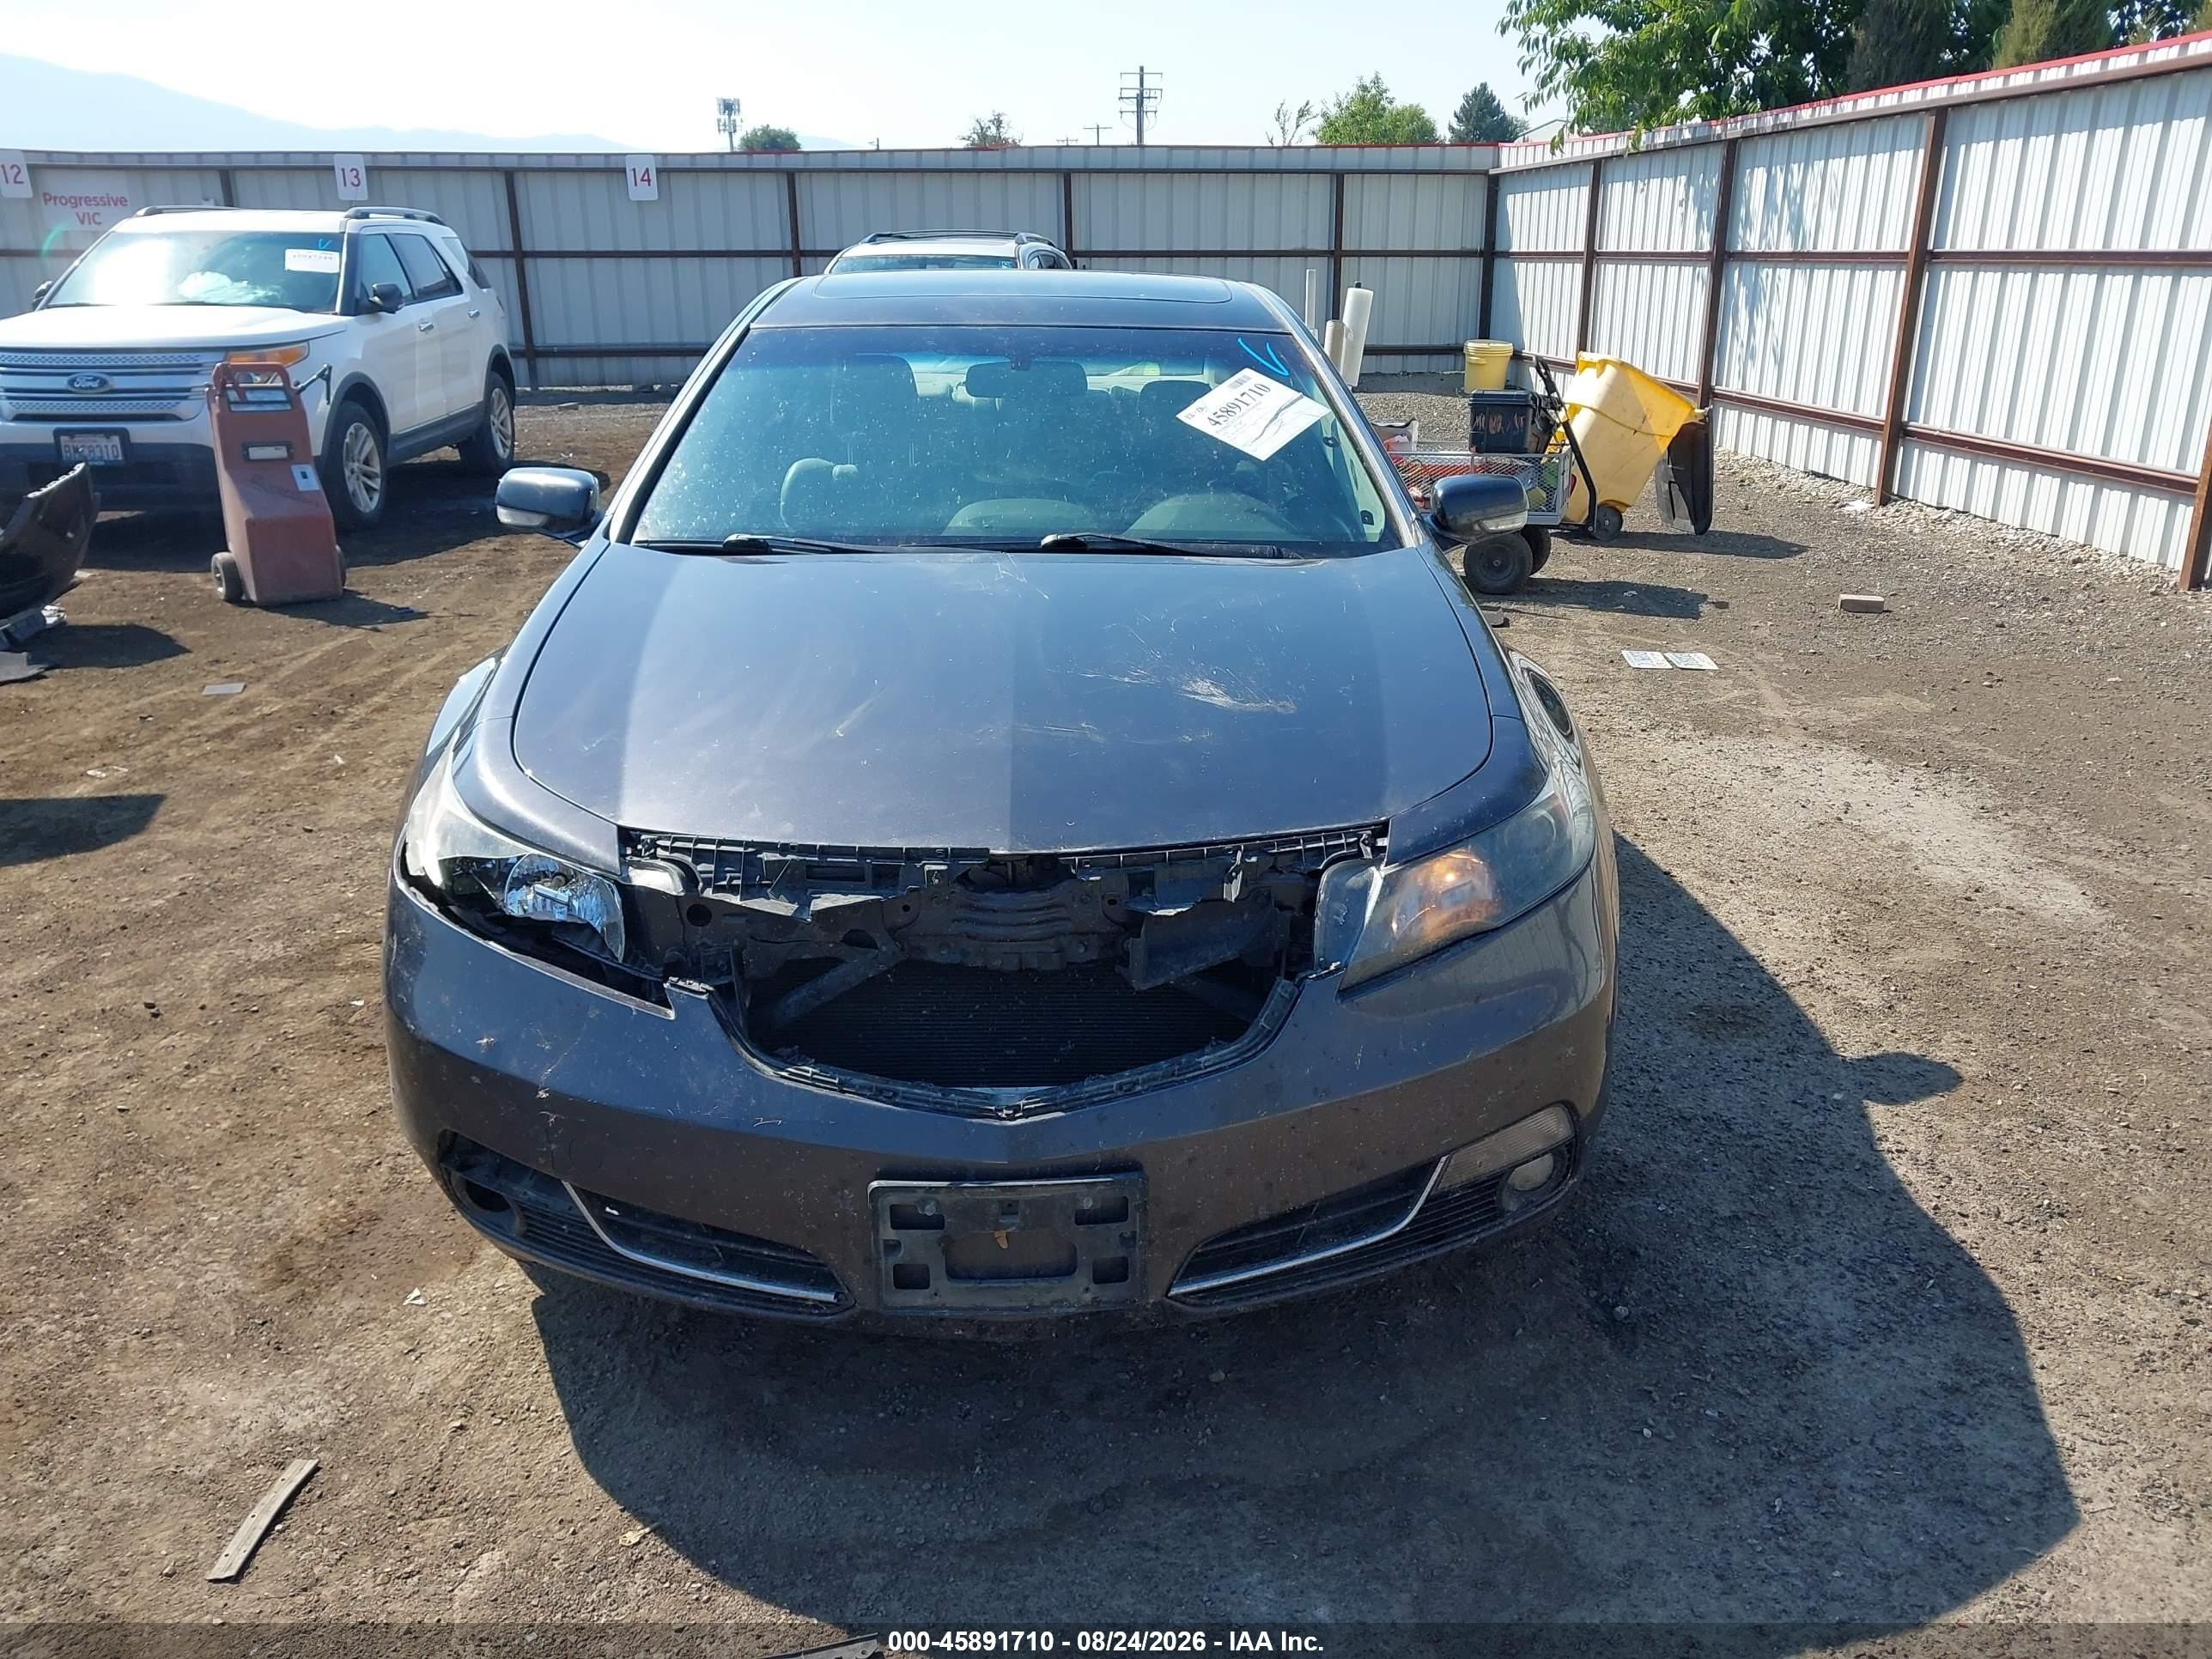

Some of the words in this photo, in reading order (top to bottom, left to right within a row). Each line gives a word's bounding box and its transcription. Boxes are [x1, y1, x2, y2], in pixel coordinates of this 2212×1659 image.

[1, 164, 25, 185] 12
[341, 167, 362, 187] 13
[631, 167, 652, 187] 14
[43, 191, 128, 209] Progressive
[76, 212, 102, 225] VIC
[74, 376, 100, 387] Ford
[1206, 383, 1272, 427] 45891710
